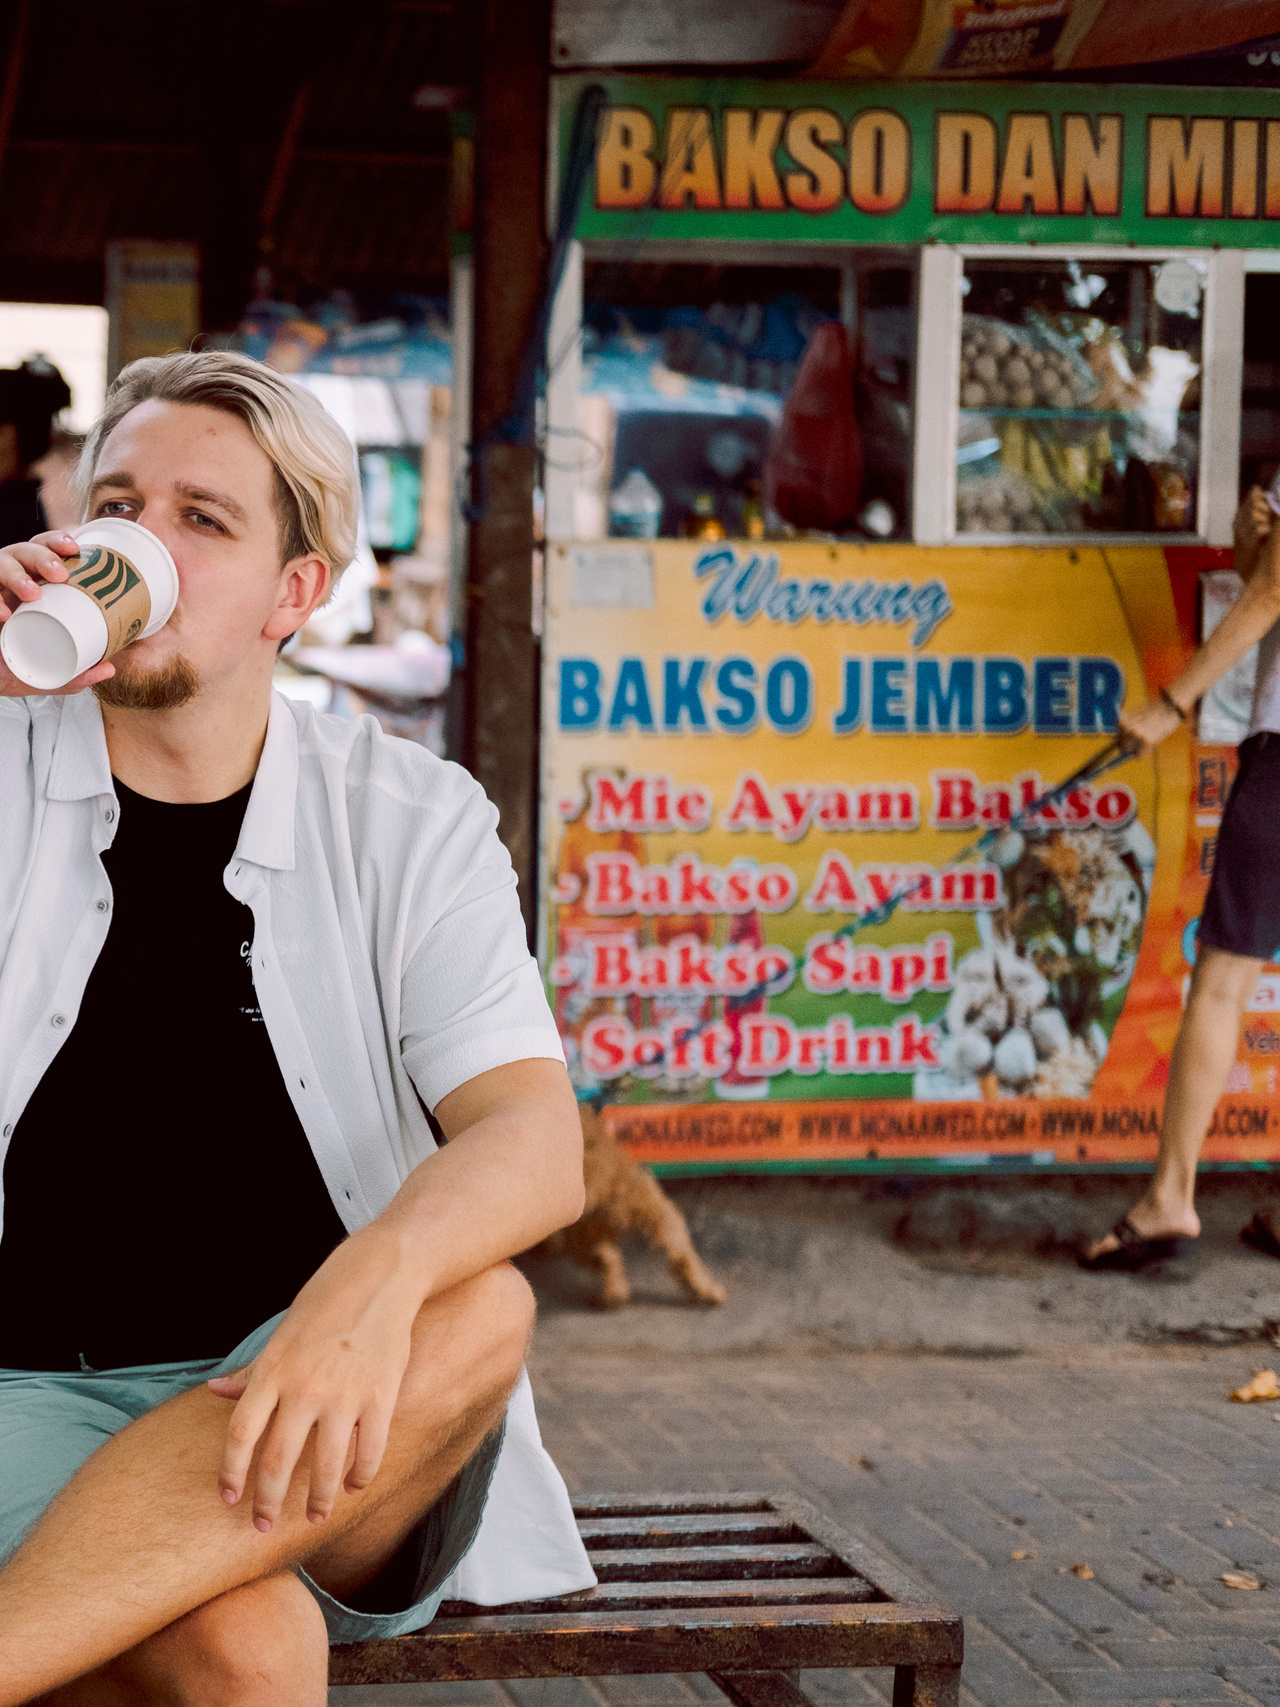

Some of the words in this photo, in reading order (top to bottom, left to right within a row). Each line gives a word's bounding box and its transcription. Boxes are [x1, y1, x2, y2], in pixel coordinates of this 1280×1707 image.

[594, 106, 913, 214] BAKSO
[934, 110, 1123, 215] DAN
[693, 545, 954, 647] Warung
[558, 657, 811, 734] BAKSO
[833, 657, 1125, 735] JEMBER
[591, 774, 709, 829] Mie
[726, 774, 917, 838] Ayam
[932, 774, 1133, 828] Bakso
[590, 859, 794, 907] Bakso
[812, 858, 1001, 913] Ayam
[588, 943, 789, 989] Bakso
[807, 937, 951, 997] Sapi
[589, 1022, 724, 1074] Soft
[745, 1019, 942, 1070] Drink
